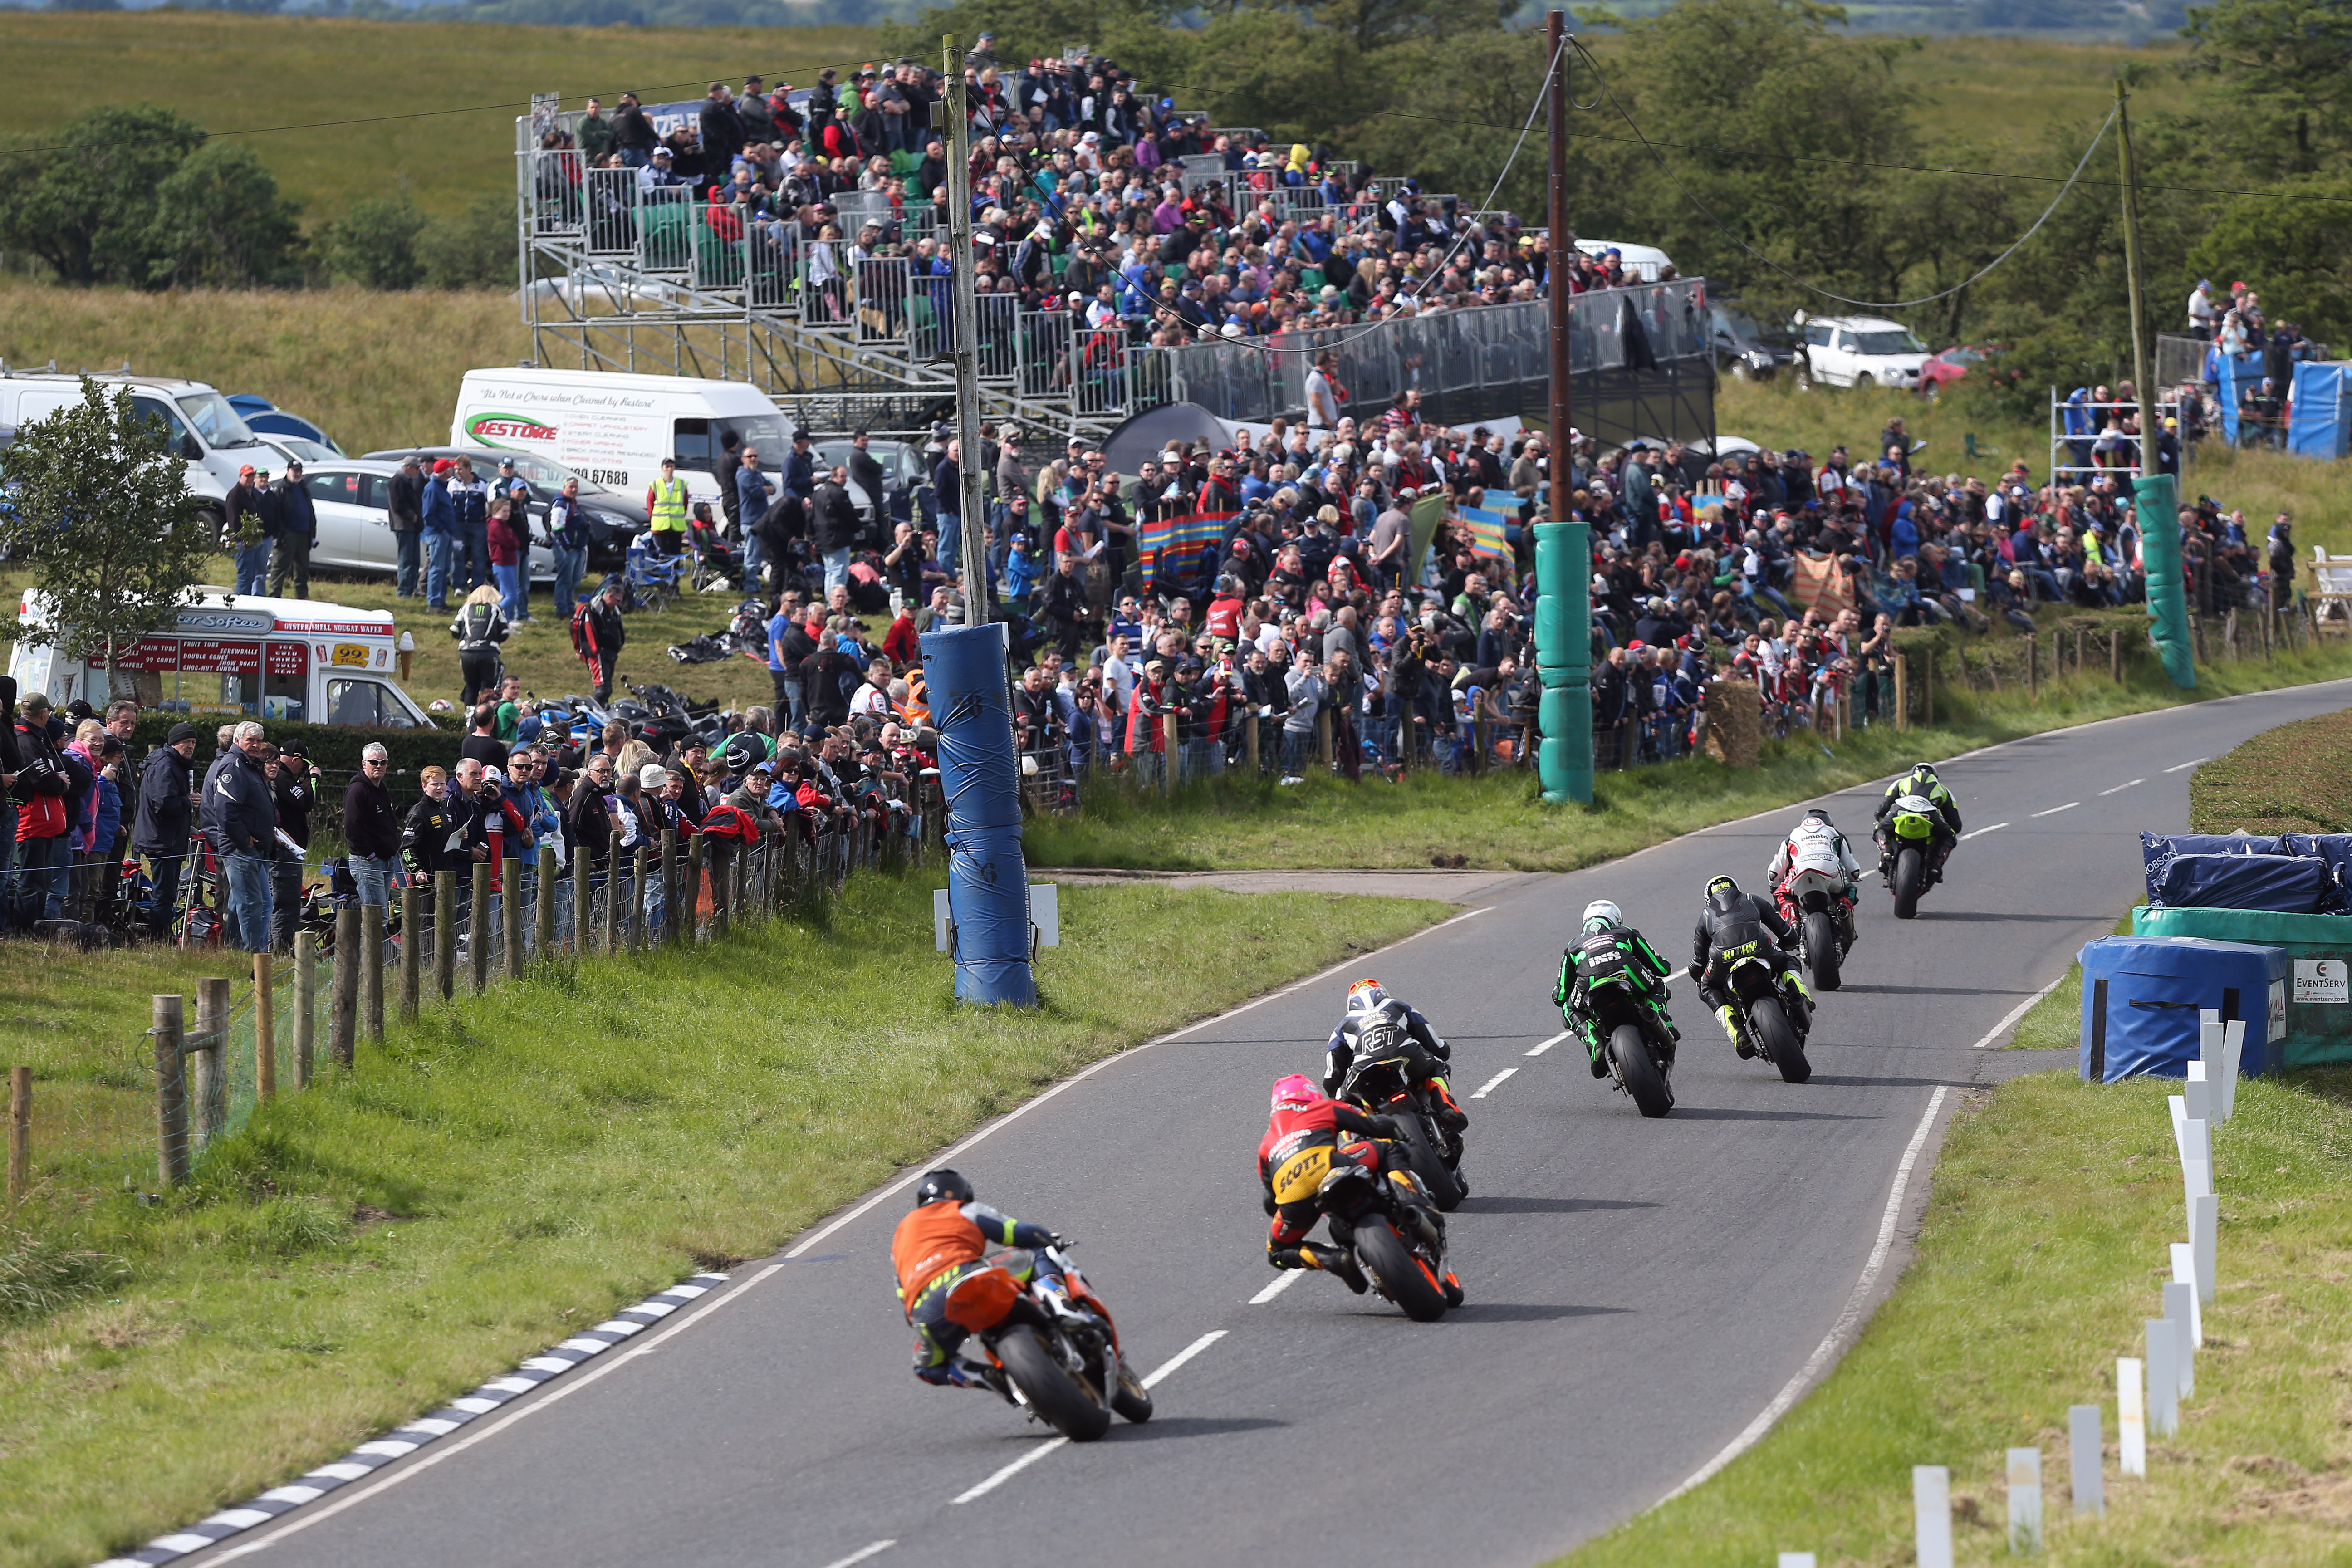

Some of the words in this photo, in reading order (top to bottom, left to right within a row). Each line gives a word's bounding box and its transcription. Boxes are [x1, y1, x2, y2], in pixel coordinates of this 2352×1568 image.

[499, 389, 515, 399] Not
[524, 391, 548, 403] Chore
[550, 393, 572, 402] when
[572, 393, 608, 405] Cleaned
[608, 396, 618, 408] by
[473, 421, 558, 440] RESTORE
[201, 615, 265, 628] Softee
[284, 623, 309, 631] OYSTER
[333, 624, 359, 632] NOUGAT
[340, 648, 362, 658] 99
[1280, 1152, 1320, 1194] SCOTT
